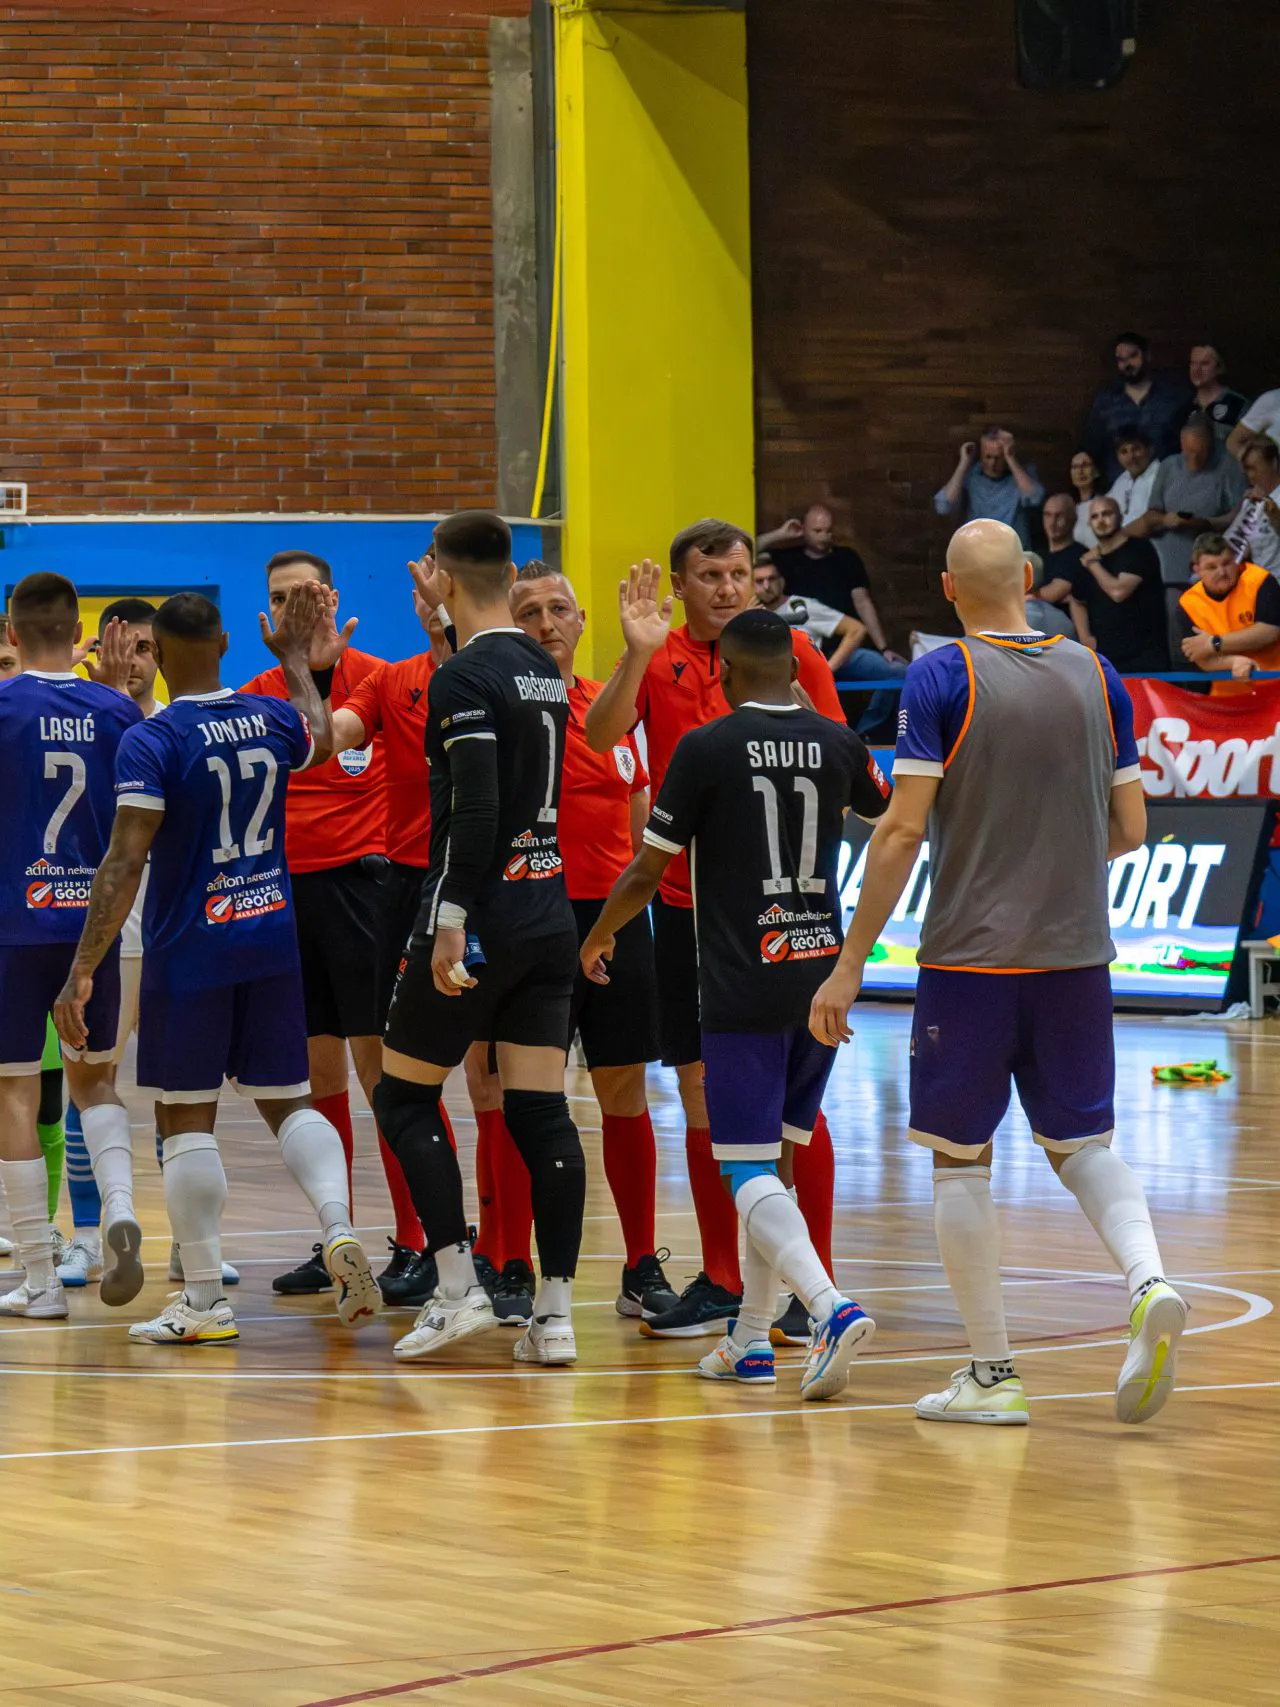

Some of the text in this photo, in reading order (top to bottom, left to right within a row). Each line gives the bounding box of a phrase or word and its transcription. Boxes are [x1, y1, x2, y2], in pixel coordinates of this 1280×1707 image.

[39, 712, 95, 742] LASIĆ
[536, 710, 558, 823] 1
[746, 740, 822, 769] SAVIO
[43, 751, 86, 854] 7
[206, 747, 278, 864] 12
[752, 776, 826, 896] 11
